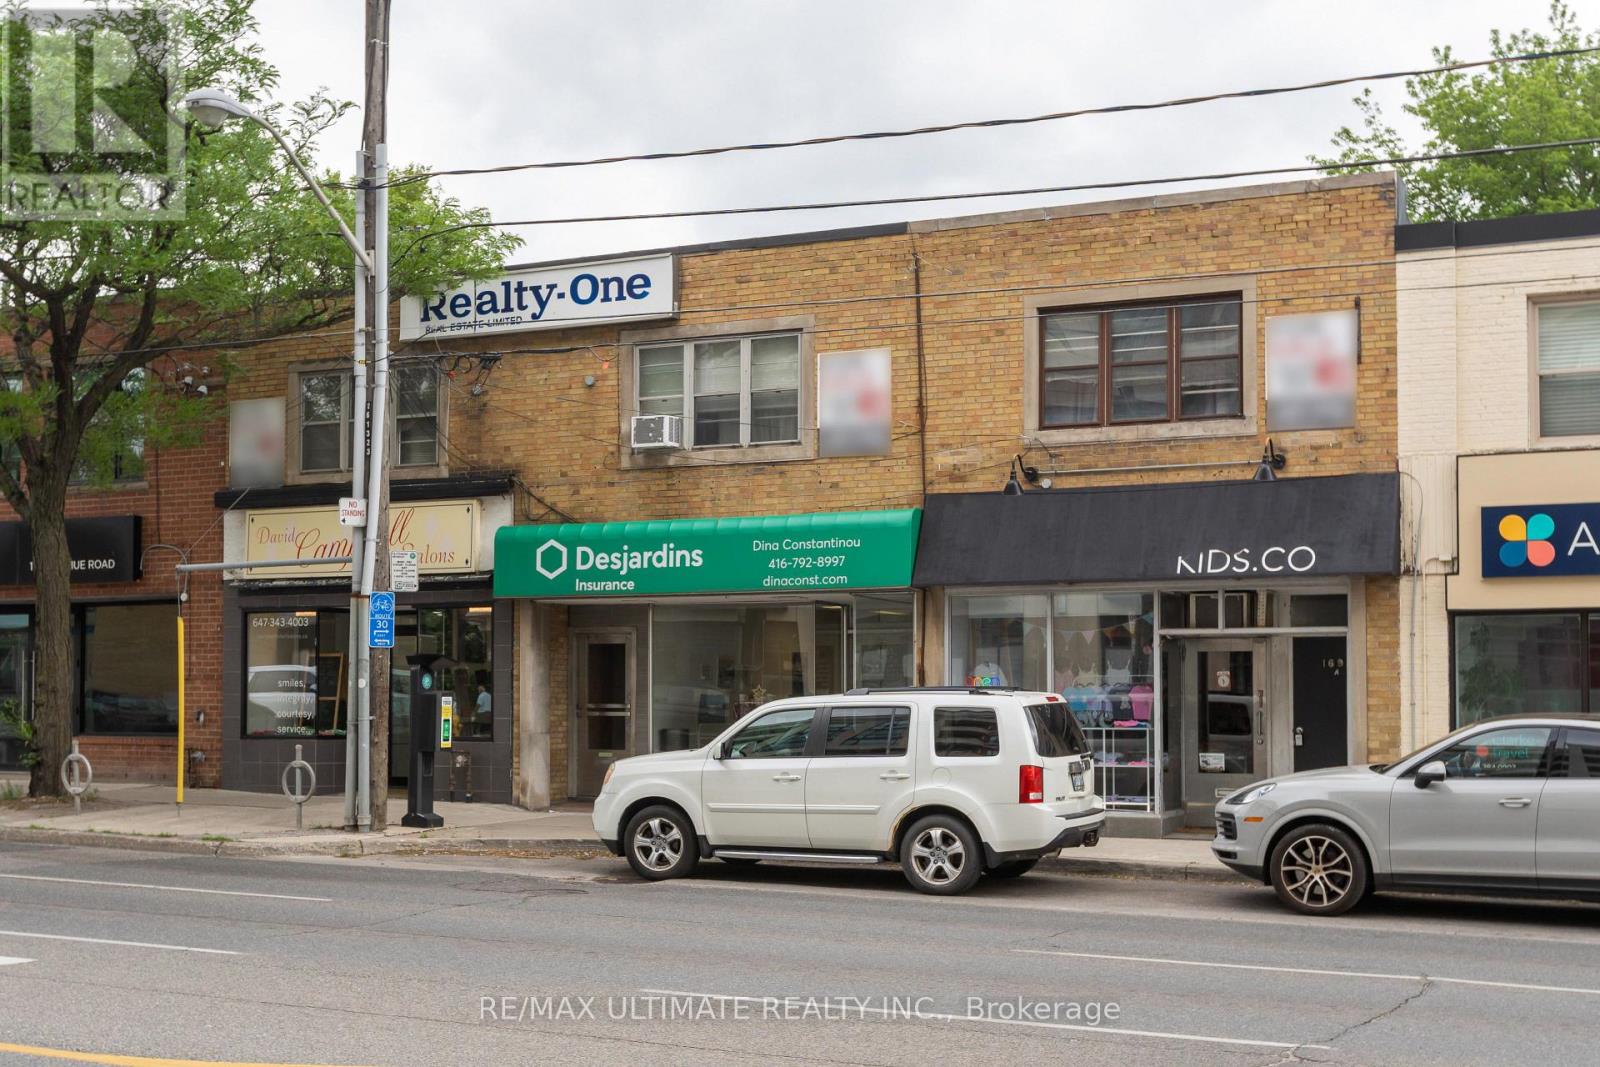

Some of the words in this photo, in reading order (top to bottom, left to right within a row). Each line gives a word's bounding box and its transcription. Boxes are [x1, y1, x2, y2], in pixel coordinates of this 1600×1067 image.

[420, 272, 652, 323] Realty-One
[449, 319, 485, 332] ESTATE
[486, 315, 523, 328] LIMITED
[341, 509, 365, 517] STANDING
[257, 526, 295, 545] David
[753, 540, 779, 551] Dina
[783, 537, 861, 550] Constantinou
[87, 559, 116, 570] ROAD
[576, 542, 703, 576] Desjardins
[768, 555, 845, 569] 416-792-8997
[1176, 545, 1316, 575] KIDS.CO
[575, 578, 635, 592] Insurance
[763, 574, 848, 588] dinaconst.com
[376, 620, 389, 629] 30
